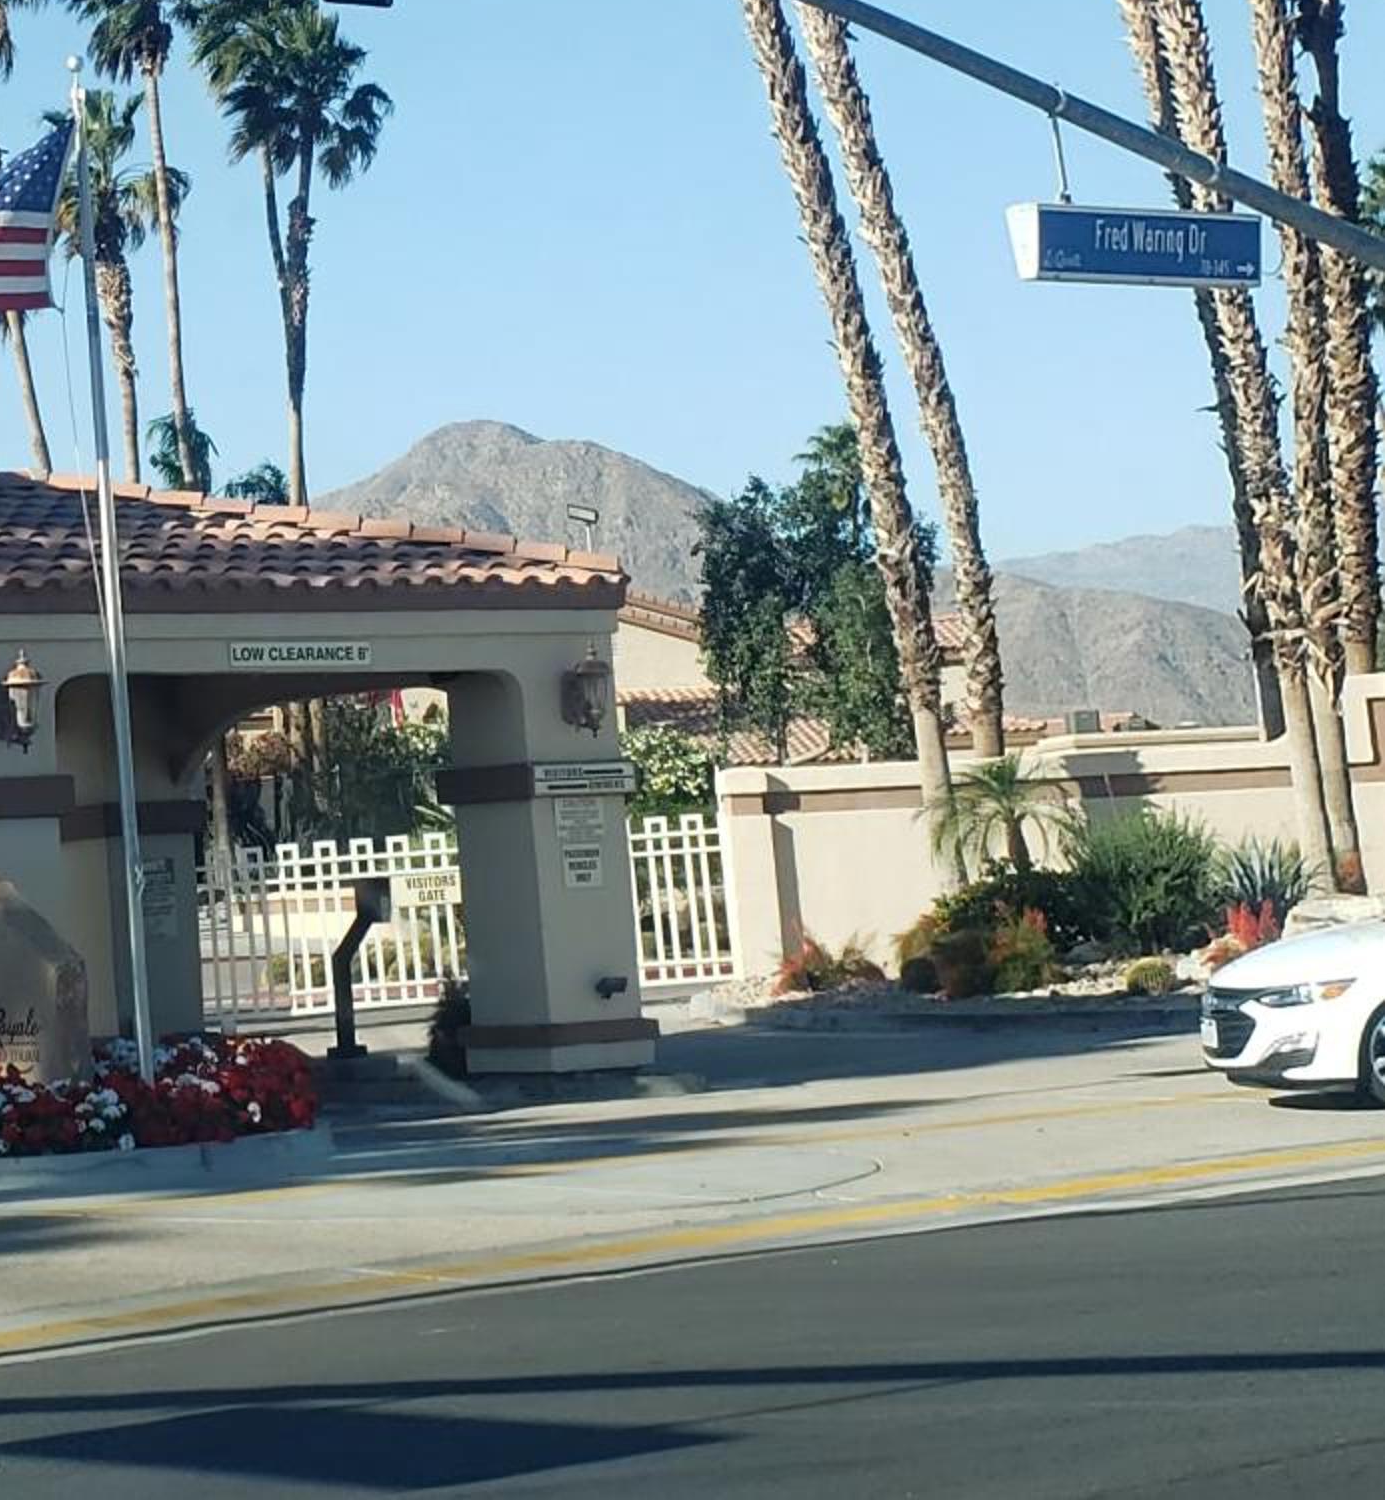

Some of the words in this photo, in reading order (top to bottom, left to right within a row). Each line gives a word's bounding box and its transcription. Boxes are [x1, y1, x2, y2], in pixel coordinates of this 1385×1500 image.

[1094, 218, 1128, 252] Fred
[1132, 221, 1185, 264] Waring
[1189, 223, 1208, 256] Dr
[232, 647, 264, 662] LOW
[268, 646, 354, 662] CLEARANCE
[405, 874, 456, 890] VISITORS
[418, 889, 446, 902] GATE
